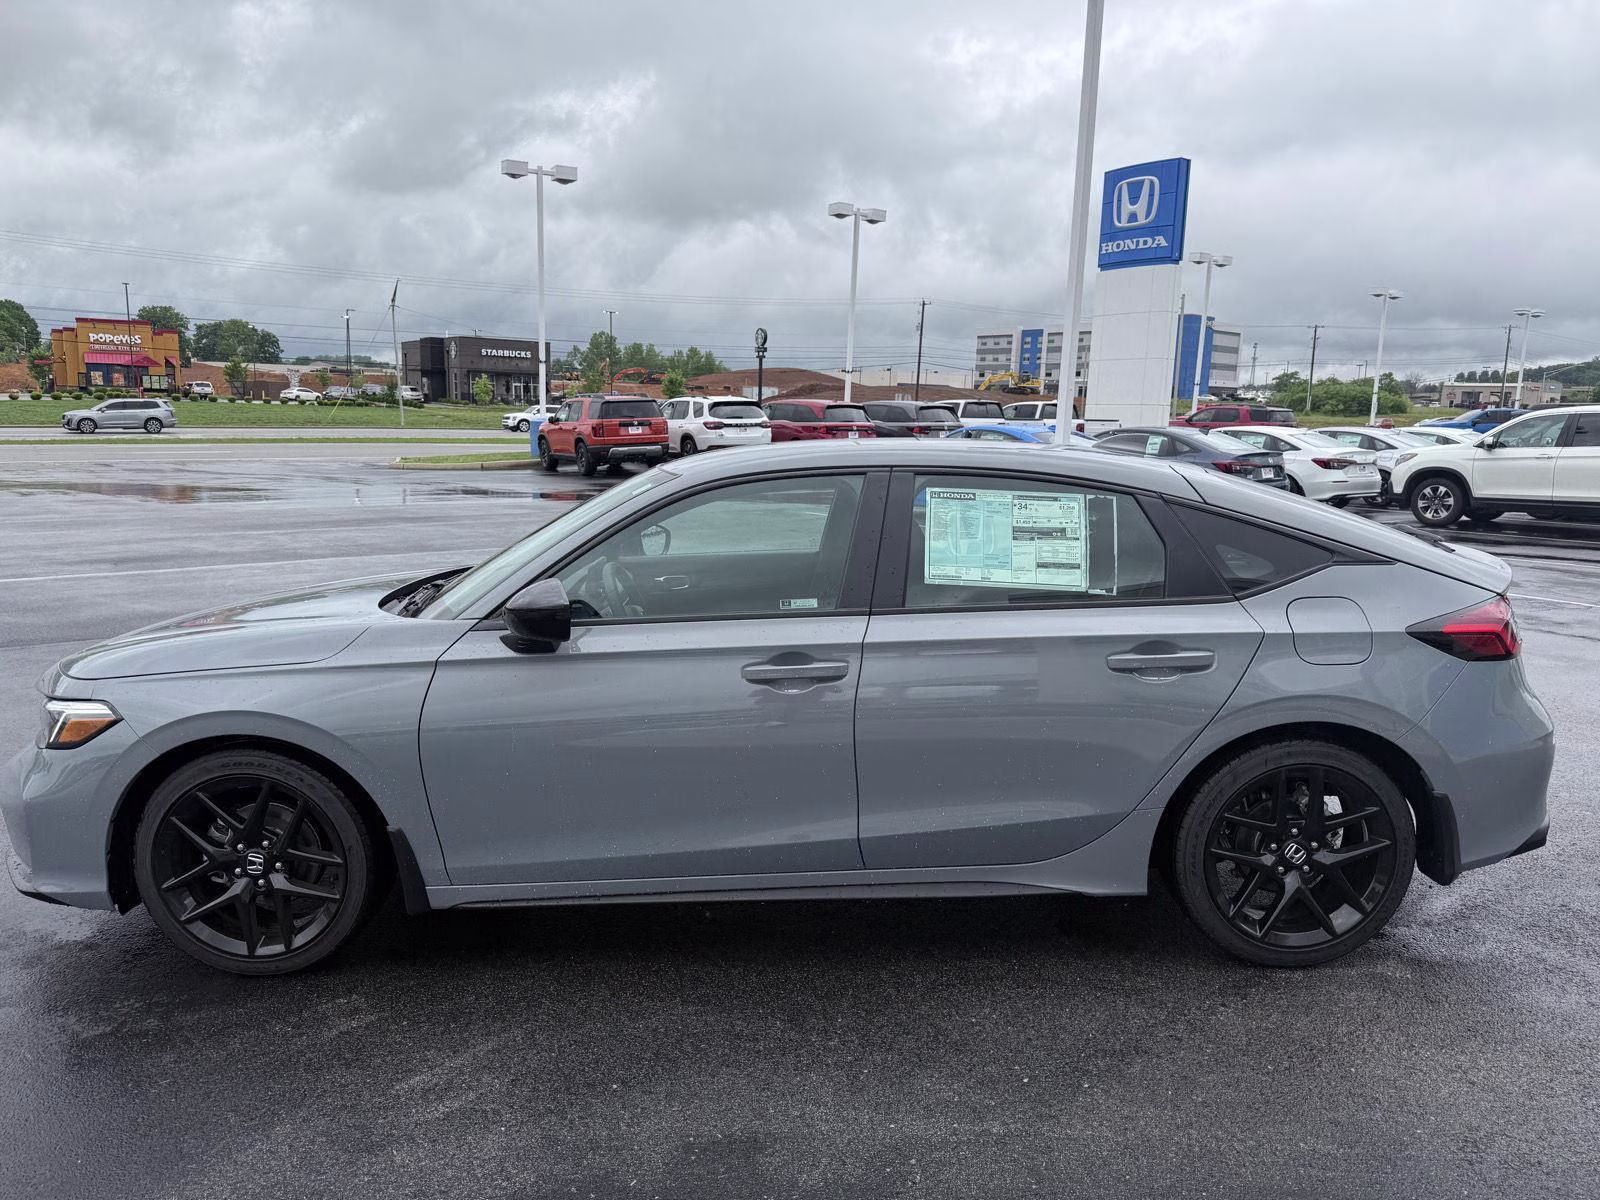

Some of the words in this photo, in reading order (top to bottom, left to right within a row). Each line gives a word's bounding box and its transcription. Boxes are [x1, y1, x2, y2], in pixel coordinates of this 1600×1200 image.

[1100, 235, 1168, 254] HONDA
[481, 349, 531, 358] STARBUCKS
[1017, 502, 1028, 510] 34
